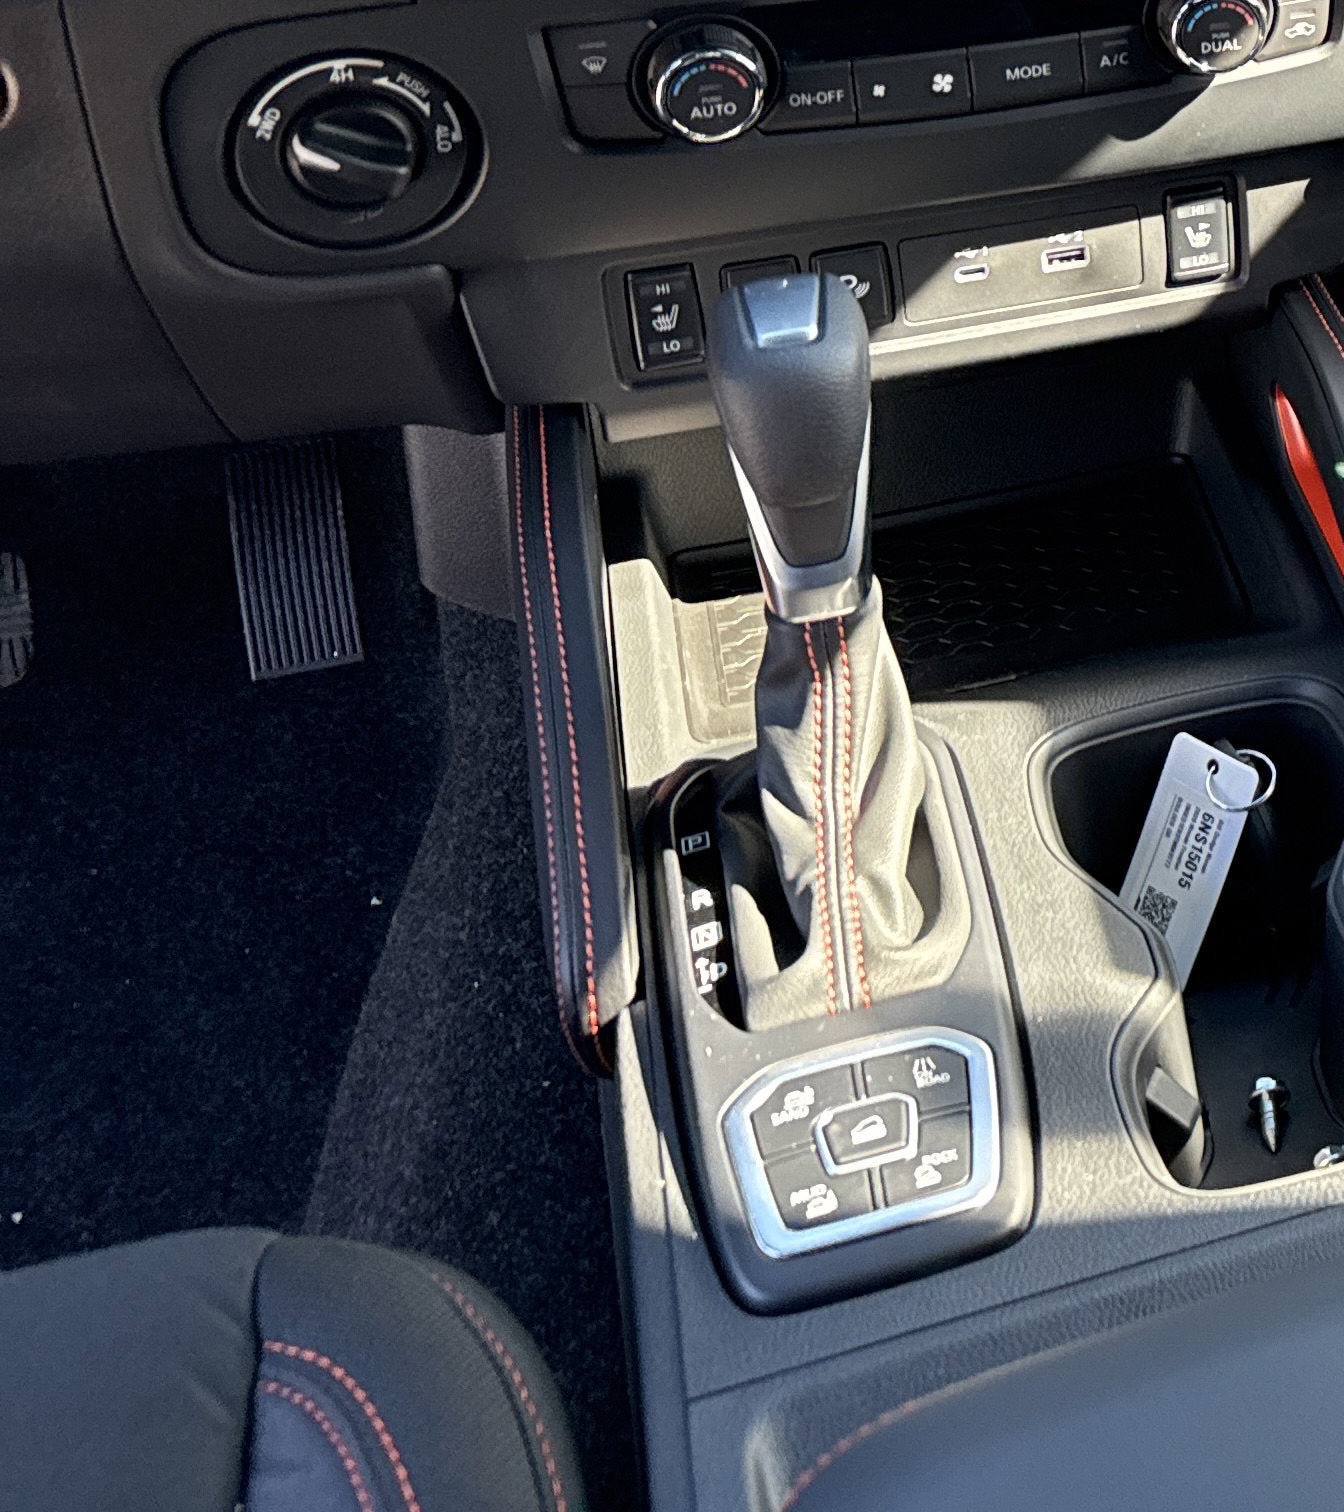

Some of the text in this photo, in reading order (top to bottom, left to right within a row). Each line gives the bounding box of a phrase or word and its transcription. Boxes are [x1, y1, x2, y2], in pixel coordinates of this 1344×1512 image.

[1200, 38, 1243, 55] DUAL
[1100, 51, 1129, 69] A/C
[1005, 63, 1051, 81] MODE
[395, 71, 431, 98] PUSH
[690, 101, 737, 120] AUTO
[255, 107, 282, 142] 2WD
[656, 283, 671, 297] HI
[662, 339, 681, 354] LO
[1177, 811, 1216, 891] 6NS15015
[691, 888, 714, 911] R
[771, 1105, 810, 1127] SAND
